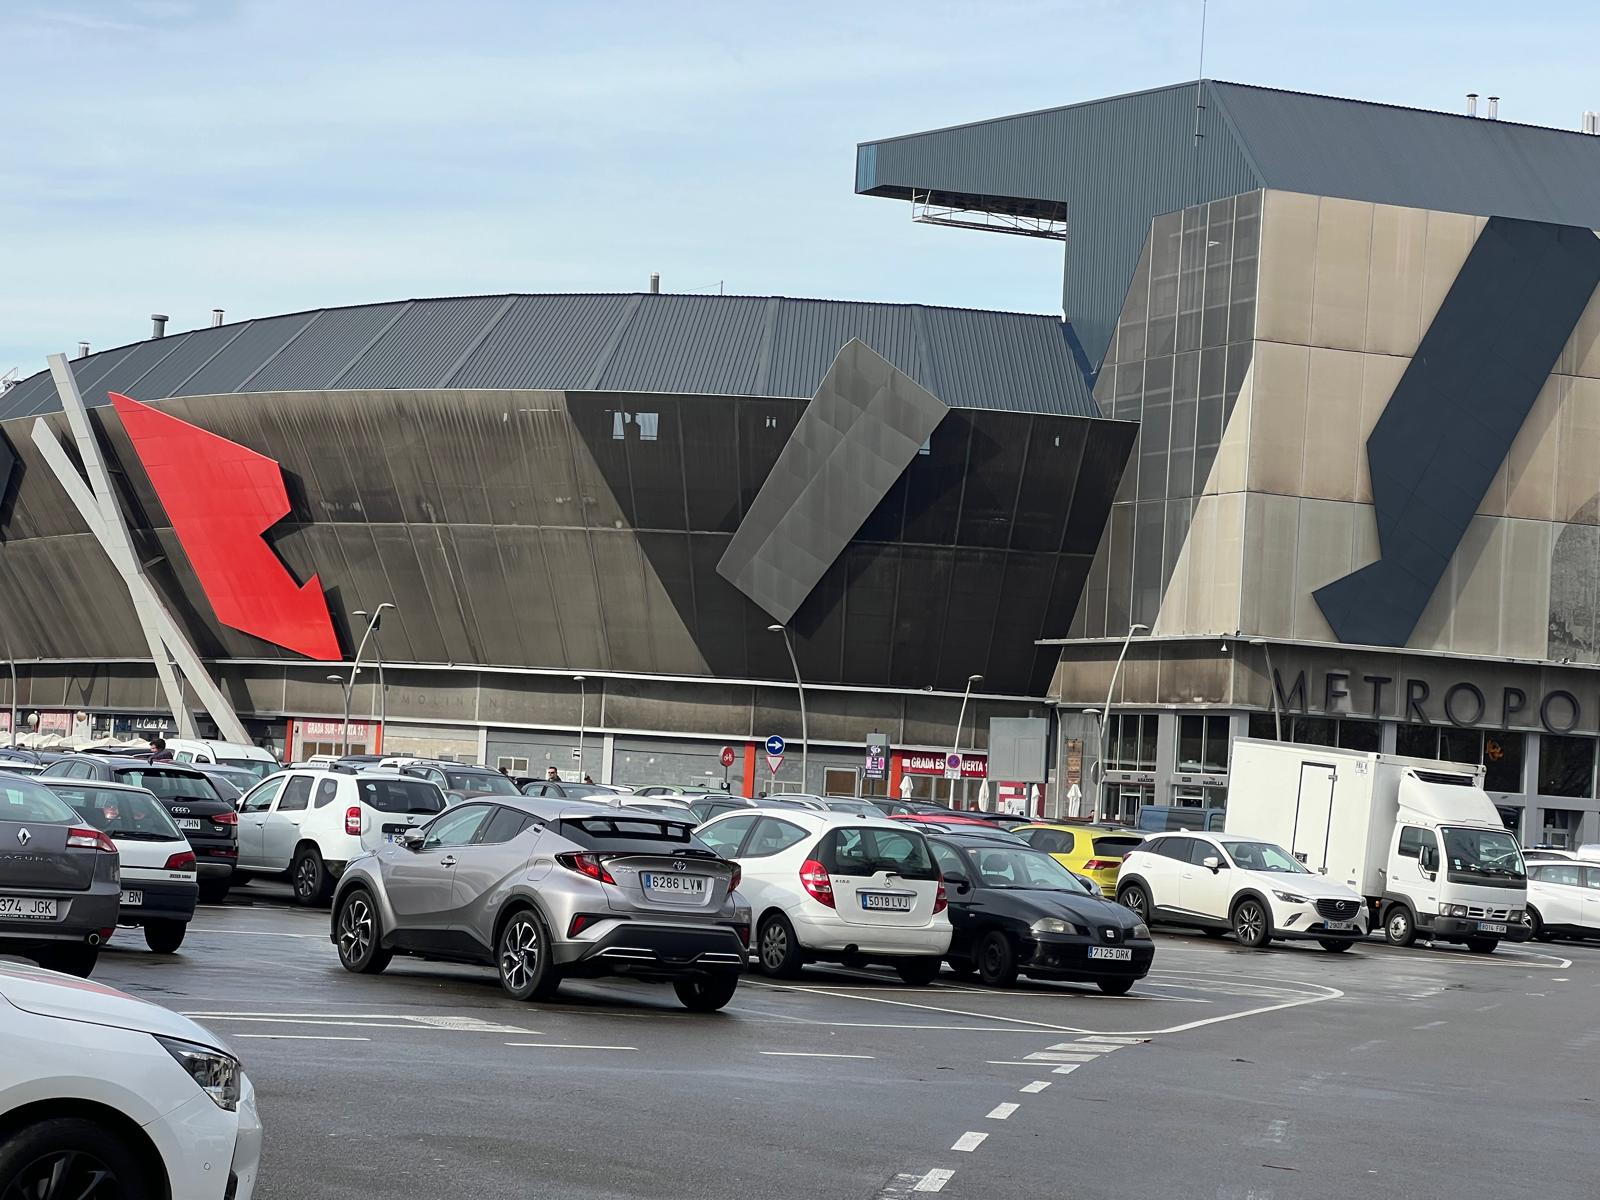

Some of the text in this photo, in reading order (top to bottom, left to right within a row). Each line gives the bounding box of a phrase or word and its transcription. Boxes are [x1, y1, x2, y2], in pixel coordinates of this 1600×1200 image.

[1267, 668, 1600, 735] METROPO
[307, 722, 324, 734] GRADA
[324, 723, 335, 735] SUR
[338, 724, 357, 736] PURTA
[911, 757, 934, 769] GRADA
[935, 758, 946, 770] ES
[961, 760, 983, 772] UERTA
[184, 820, 199, 828] JHN
[652, 876, 680, 889] 6286
[128, 891, 142, 903] BN
[868, 896, 908, 908] 5018 LVJ
[0, 898, 53, 914] 374 JGK
[1093, 947, 1130, 960] 7125 DRK
